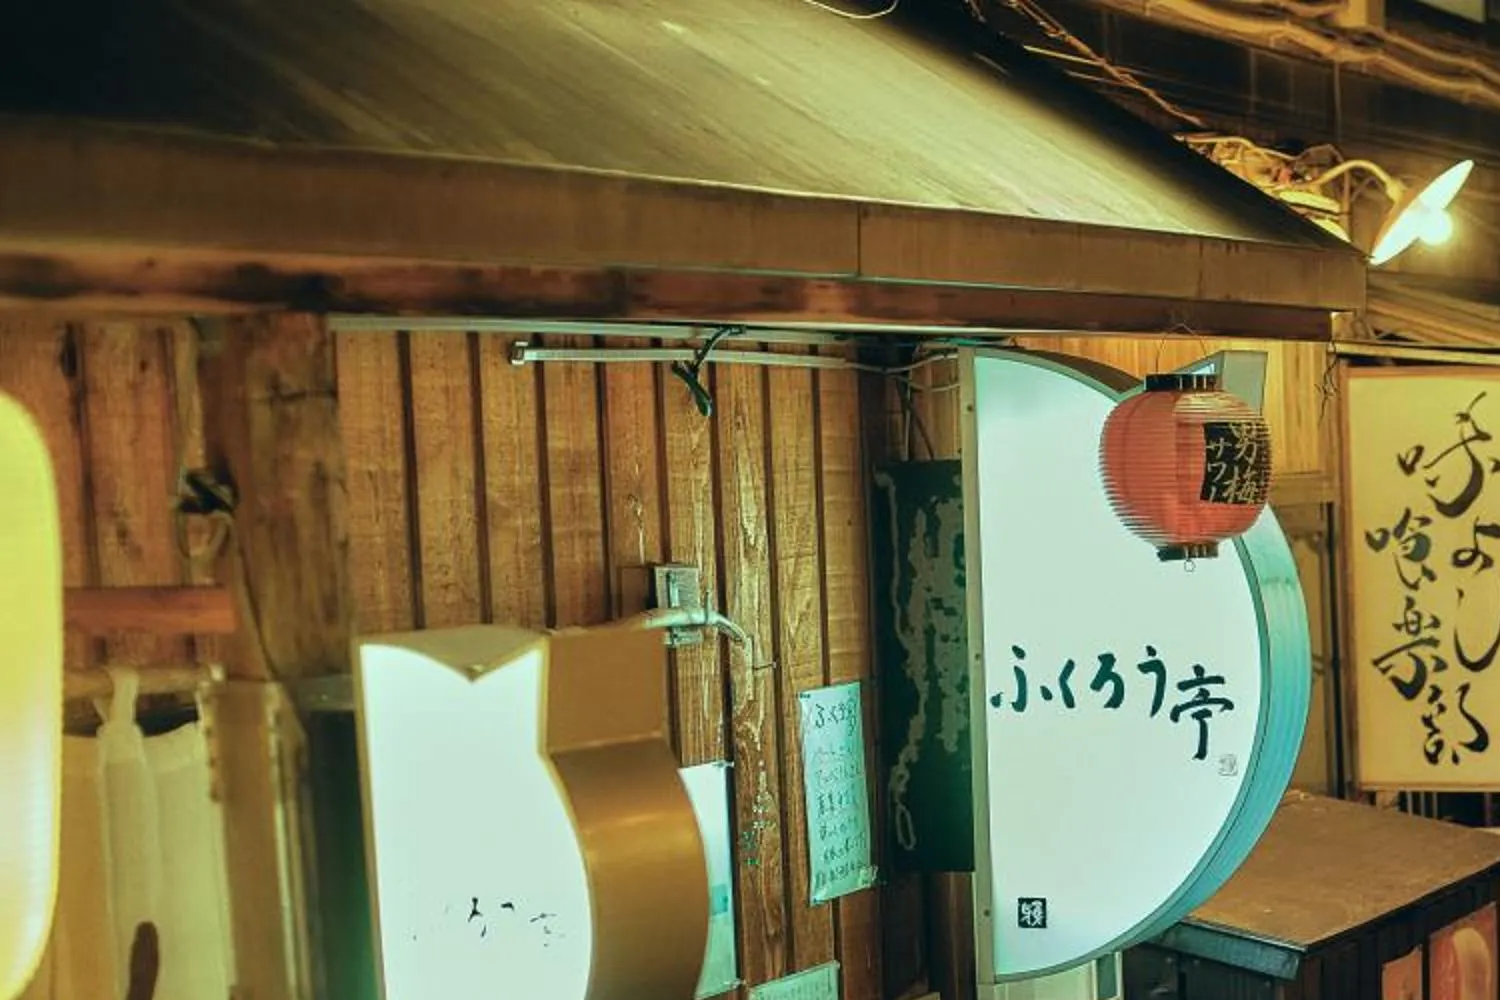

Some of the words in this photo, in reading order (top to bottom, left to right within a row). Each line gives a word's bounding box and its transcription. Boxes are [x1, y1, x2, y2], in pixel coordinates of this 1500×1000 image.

[1205, 437, 1232, 504] サワー
[989, 644, 1236, 761] ふくろう亭
